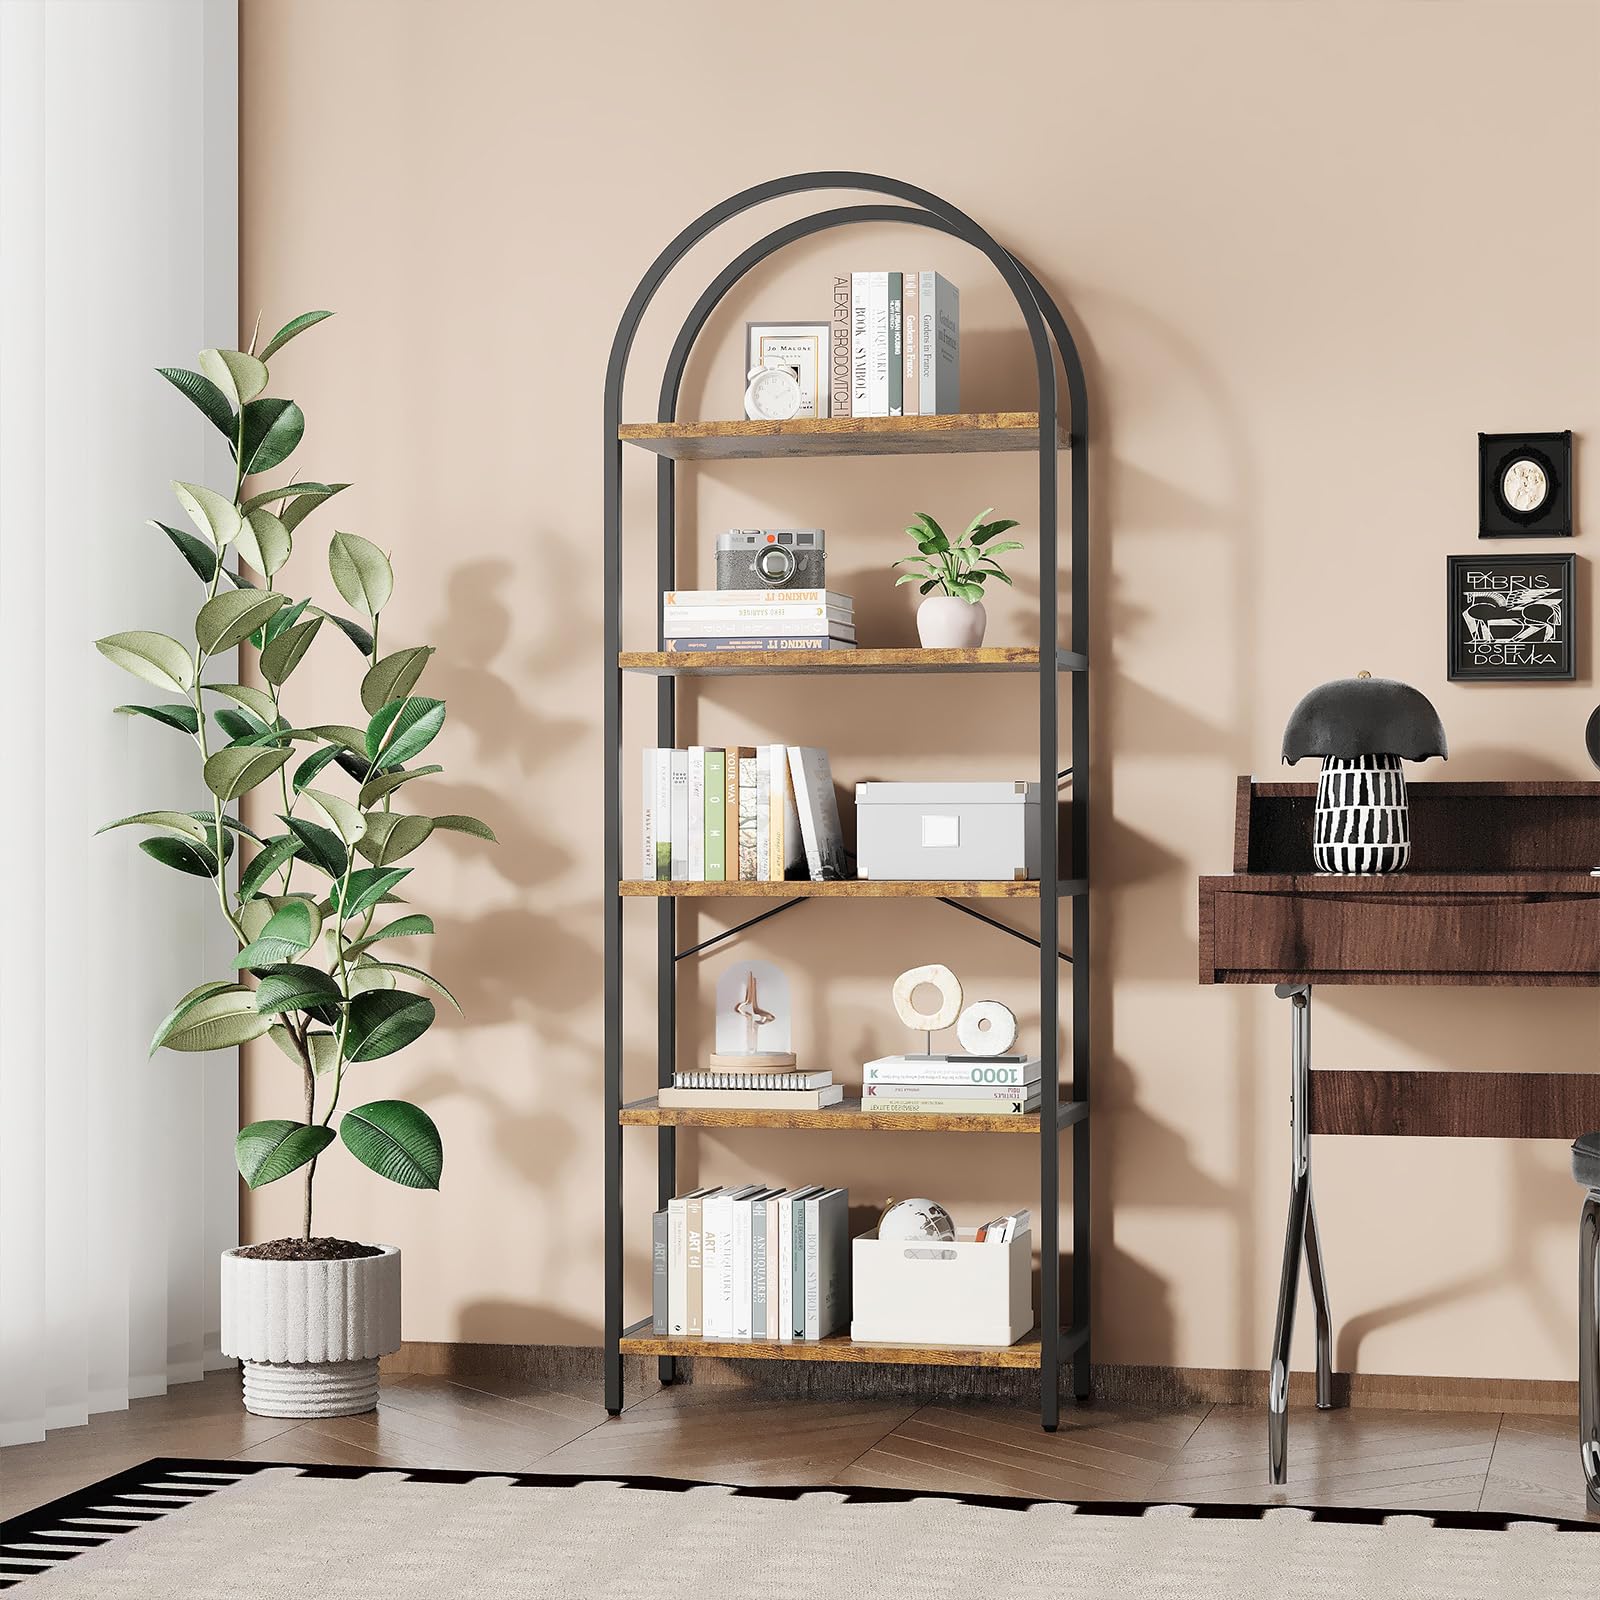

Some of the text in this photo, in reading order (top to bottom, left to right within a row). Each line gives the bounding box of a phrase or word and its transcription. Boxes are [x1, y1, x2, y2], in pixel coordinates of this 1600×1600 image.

[855, 307, 867, 337] BOOK
[906, 315, 916, 344] Gardens
[833, 276, 849, 411] ALEXEY BRODOVITCH
[875, 309, 887, 382] ANTIQUAIRES
[923, 314, 932, 378] Gardens in France
[855, 347, 867, 400] SYMBOLS
[906, 353, 916, 378] France
[764, 592, 777, 601] IT
[779, 592, 818, 601] MAKING
[766, 639, 779, 649] IT
[780, 639, 822, 650] MAKING
[1468, 644, 1526, 654] JOSEF
[971, 1069, 1018, 1083] 1000
[655, 1242, 664, 1258] ART
[689, 1231, 700, 1253] ART
[705, 1231, 716, 1253] ART
[721, 1232, 731, 1302] ANTIQUAIRES
[756, 1235, 765, 1304] ANTIQUAIRES
[807, 1234, 817, 1321] BOOK SYMBOLS
